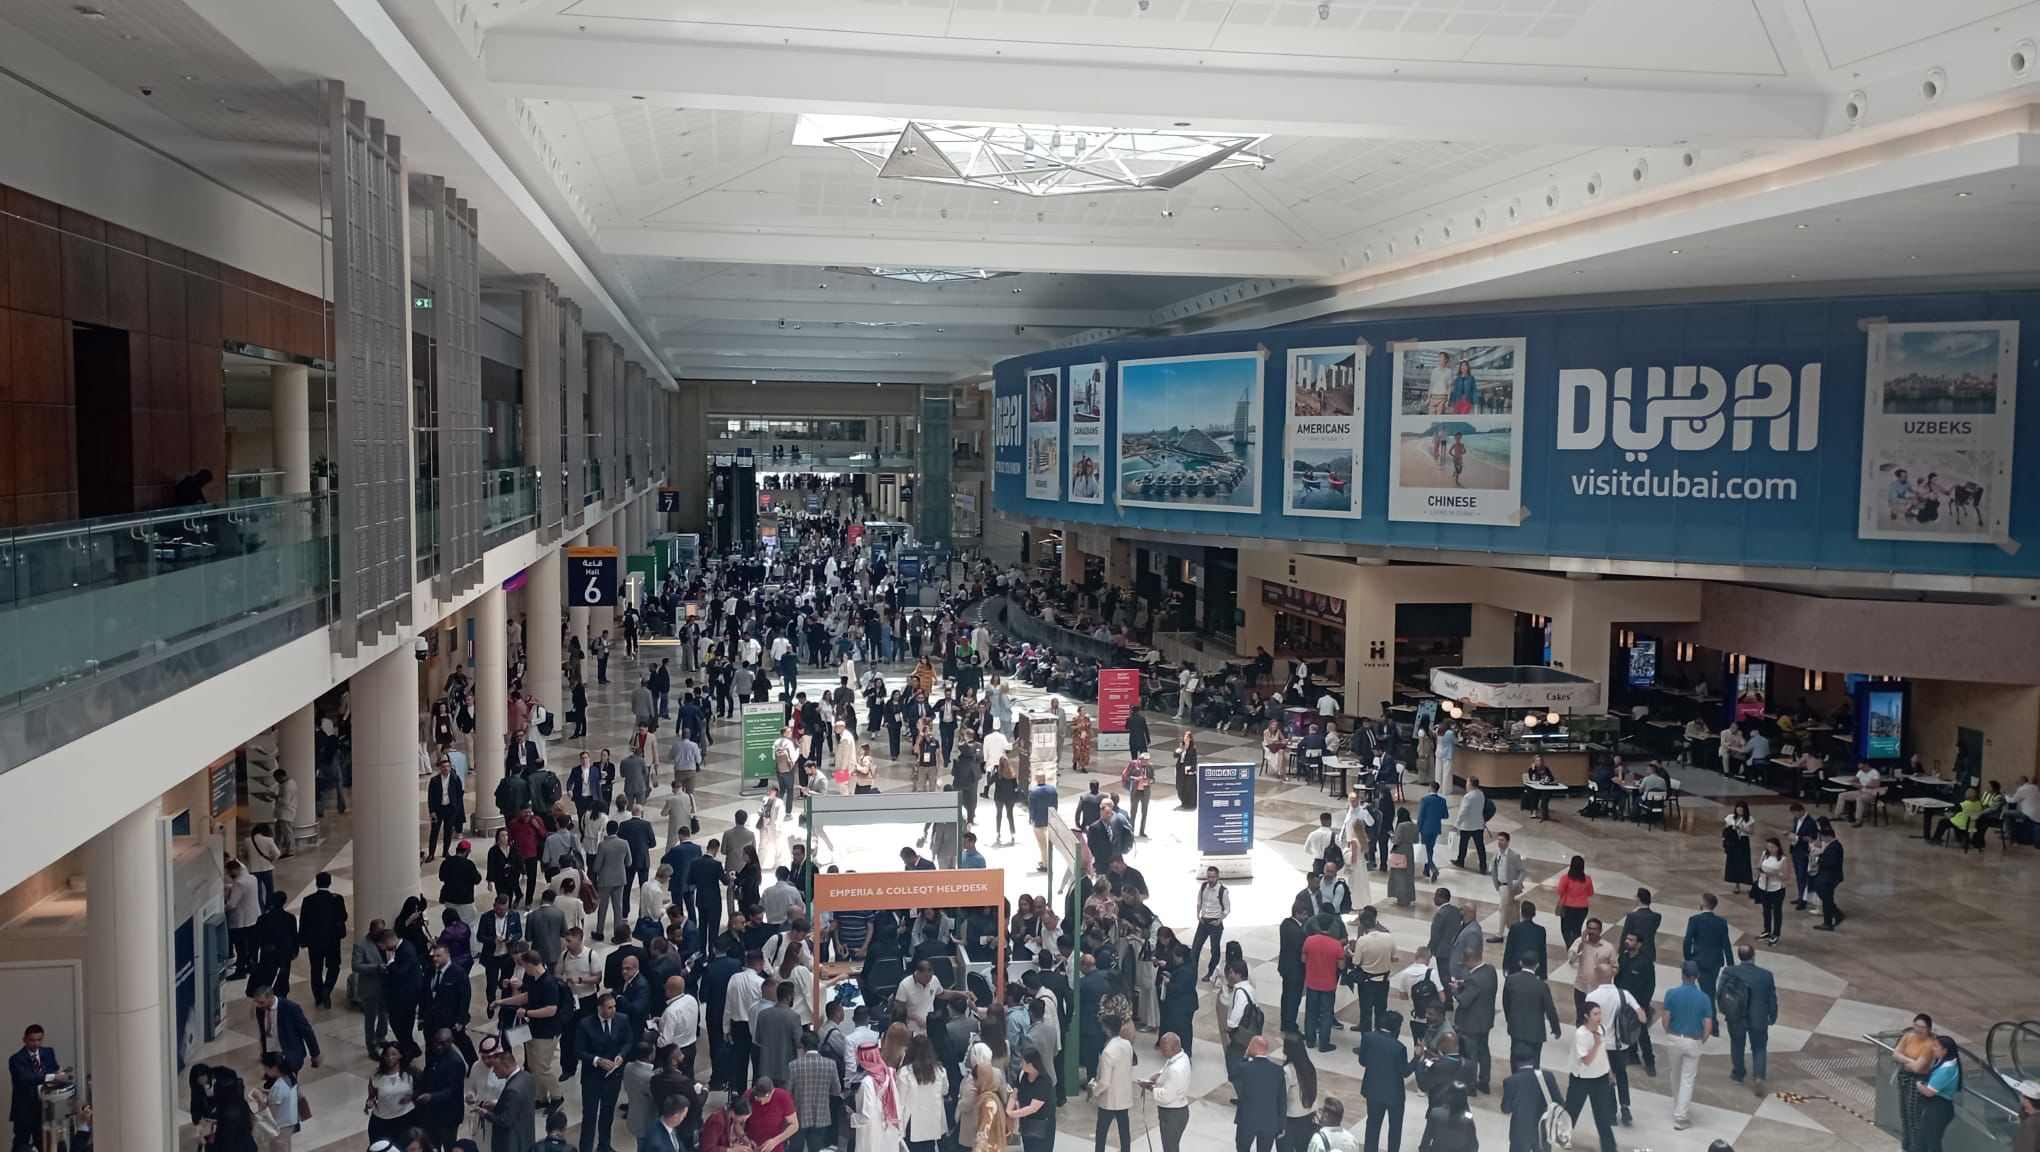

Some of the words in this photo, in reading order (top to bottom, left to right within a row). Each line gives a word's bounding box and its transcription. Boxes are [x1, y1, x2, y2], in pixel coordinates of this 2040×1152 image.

[1557, 363, 1822, 460] DUBAI
[1296, 423, 1351, 434] AMERICANS
[1904, 421, 1972, 434] UZBEKS
[1571, 468, 1798, 500] visitdubai.com
[665, 499, 673, 511] 7
[1427, 495, 1478, 508] CHINESE
[585, 568, 600, 576] Hall
[584, 576, 602, 604] 6
[1545, 692, 1571, 701] Cakes
[830, 889, 874, 898] EMPERIA
[876, 888, 884, 896] &
[886, 886, 934, 896] COLLEQT
[937, 883, 988, 893] HELPDESK
